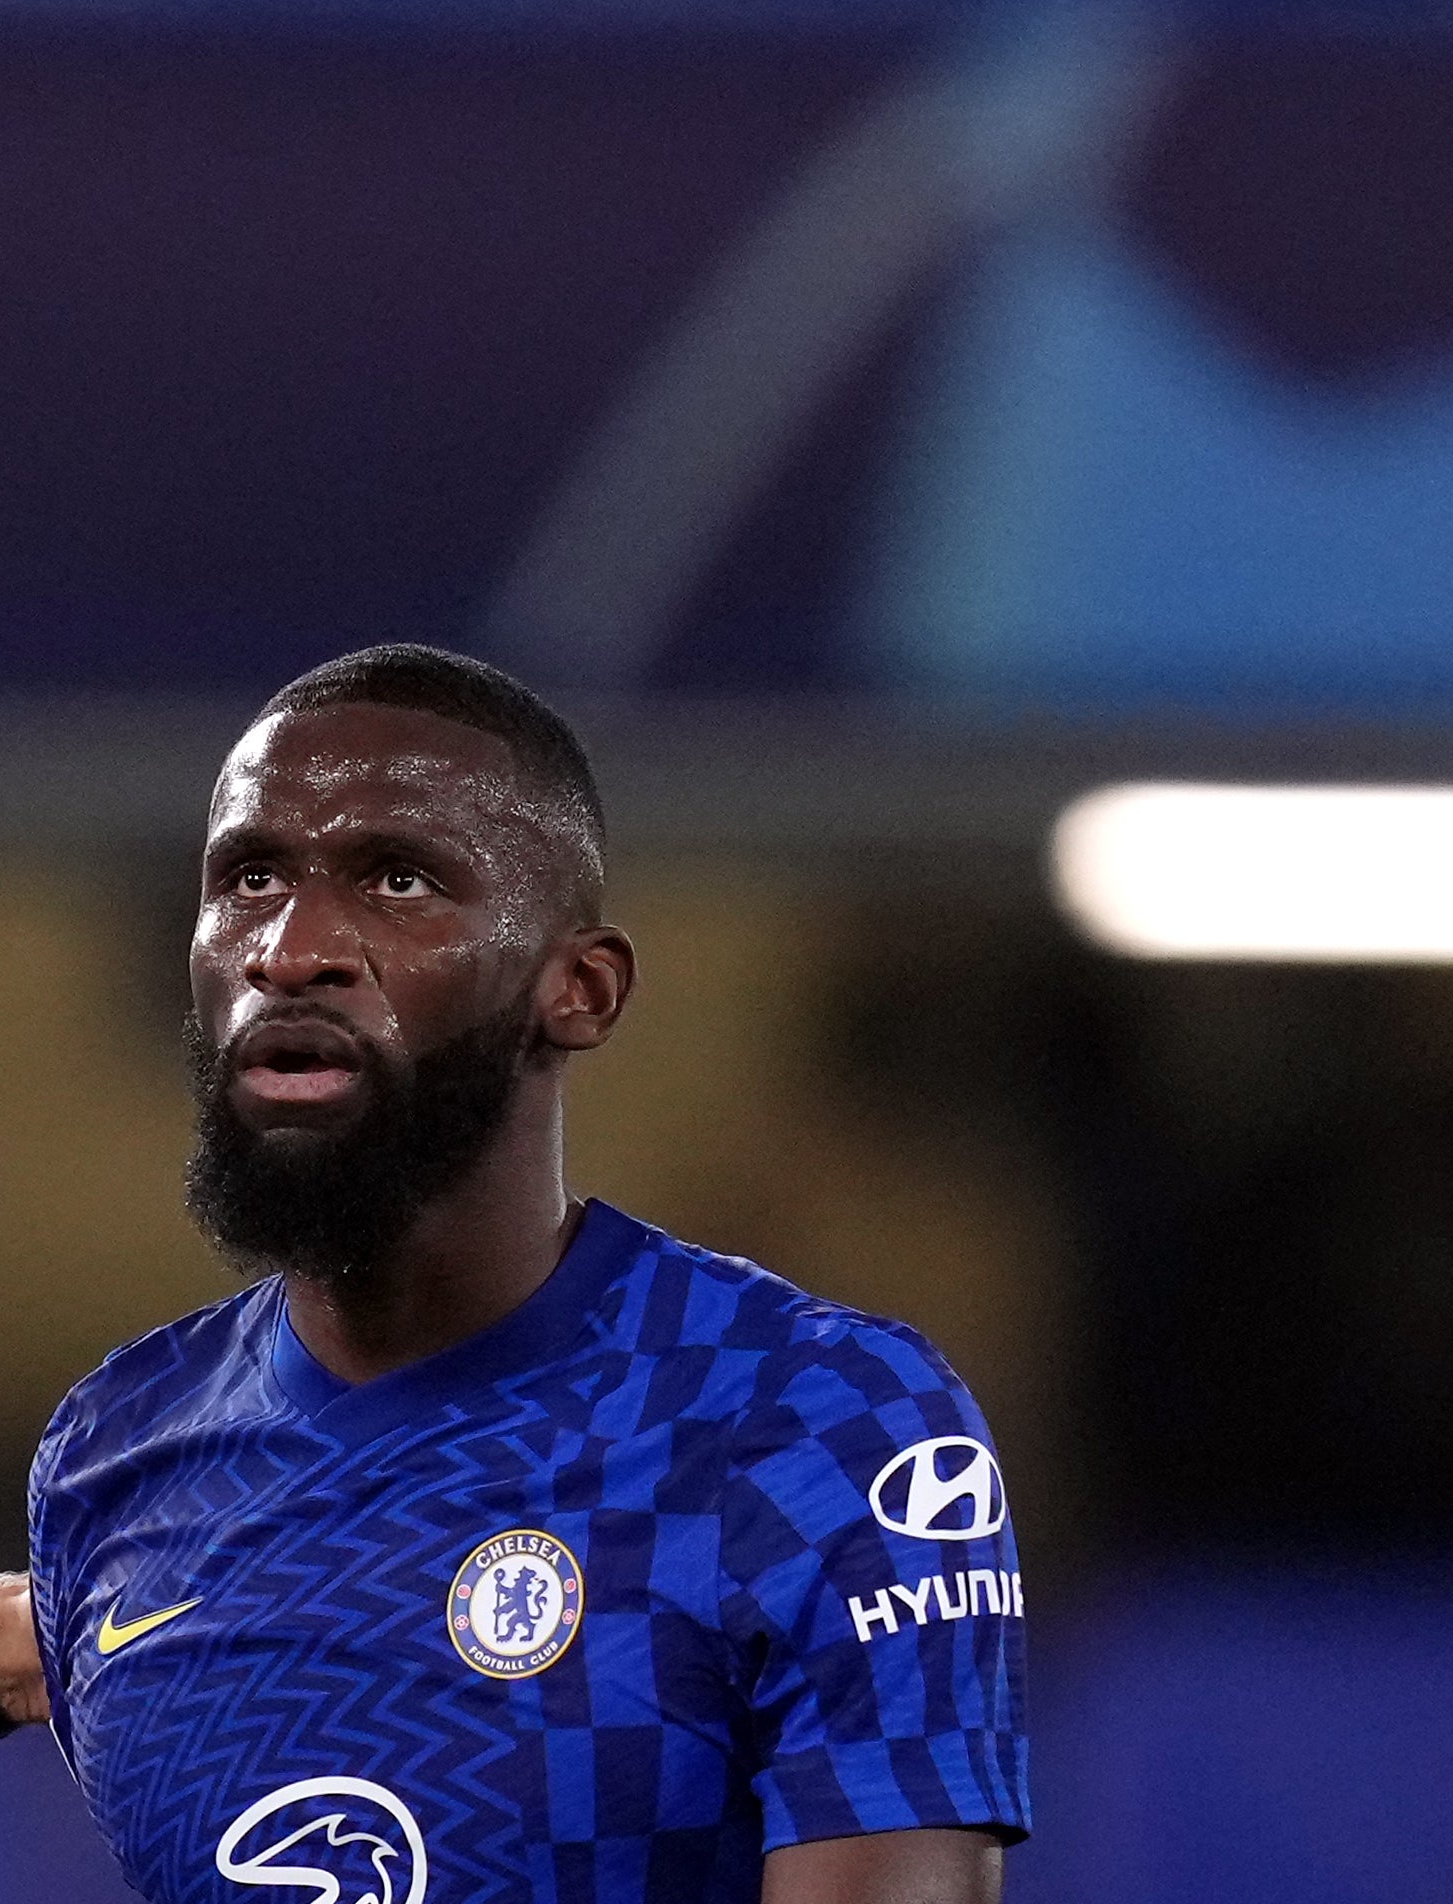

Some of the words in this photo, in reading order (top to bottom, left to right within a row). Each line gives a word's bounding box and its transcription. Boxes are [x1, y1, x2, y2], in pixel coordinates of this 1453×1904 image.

[476, 1536, 561, 1569] CHELSEA
[468, 1646, 525, 1670] FOOTBALL
[530, 1641, 559, 1665] CLUB
